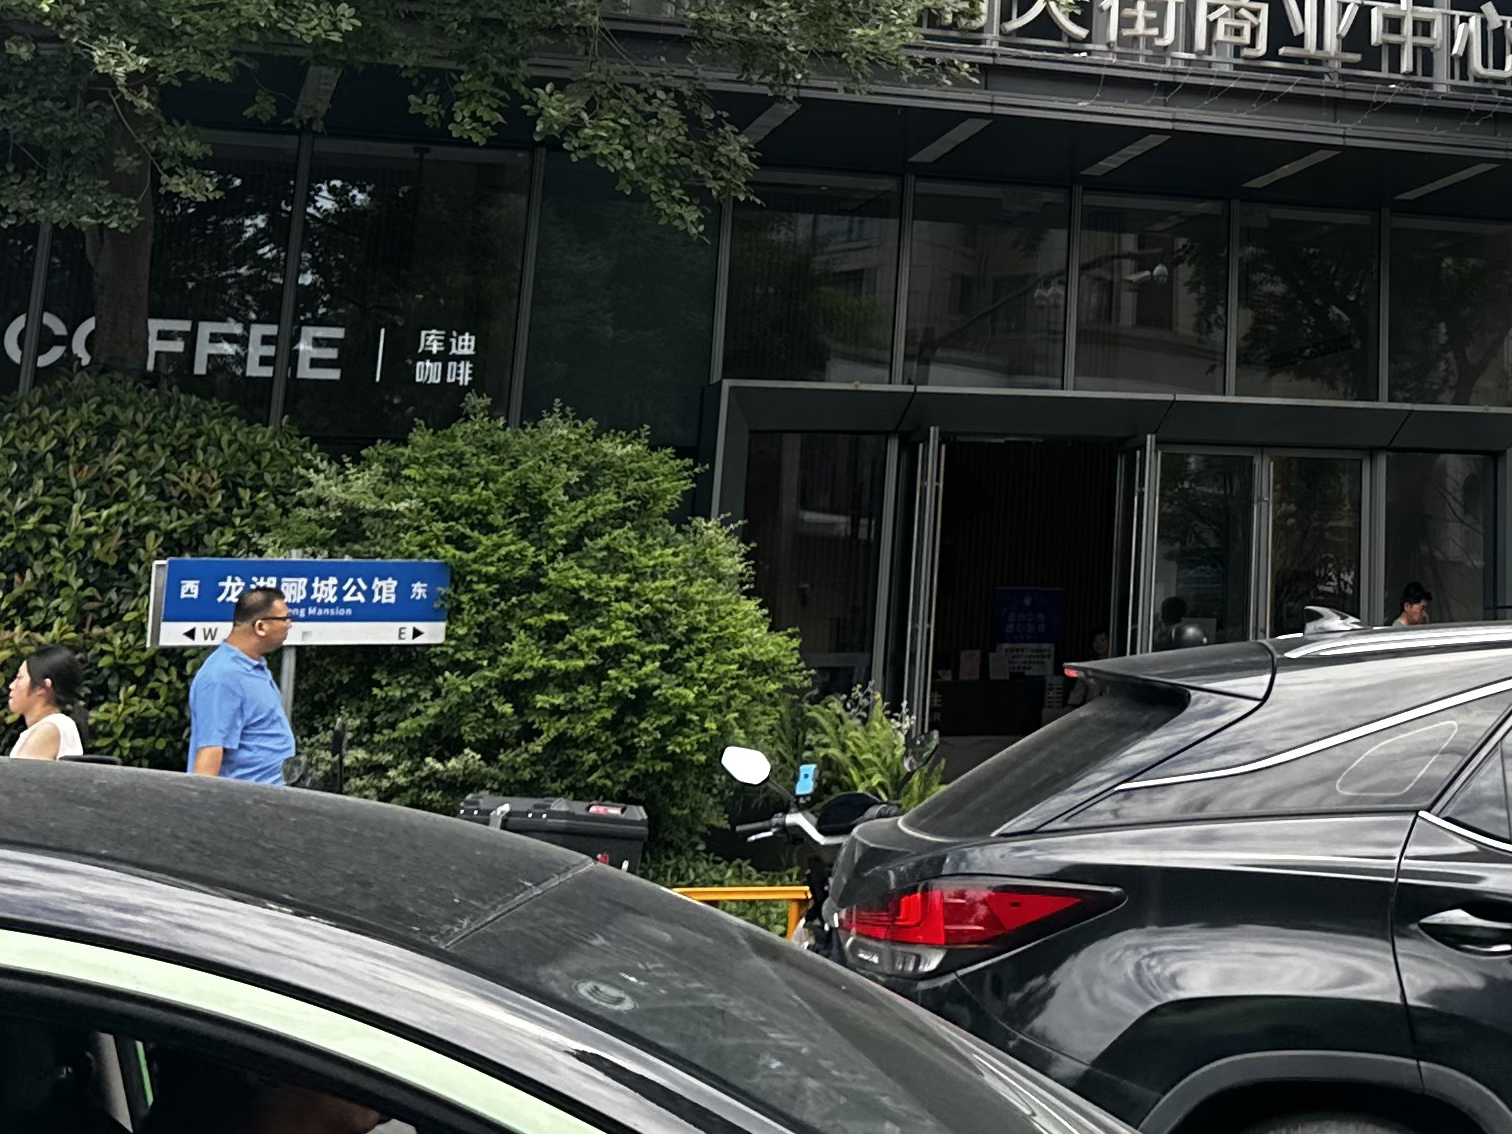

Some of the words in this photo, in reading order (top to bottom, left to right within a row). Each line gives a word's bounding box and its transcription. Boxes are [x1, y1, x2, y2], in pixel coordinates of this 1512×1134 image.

[417, 328, 477, 356] 库迪
[414, 358, 474, 387] 咖啡
[179, 579, 200, 600] 西
[409, 581, 429, 601] 东
[307, 605, 353, 616] Mansion
[202, 627, 219, 642] W
[397, 626, 408, 641] E
